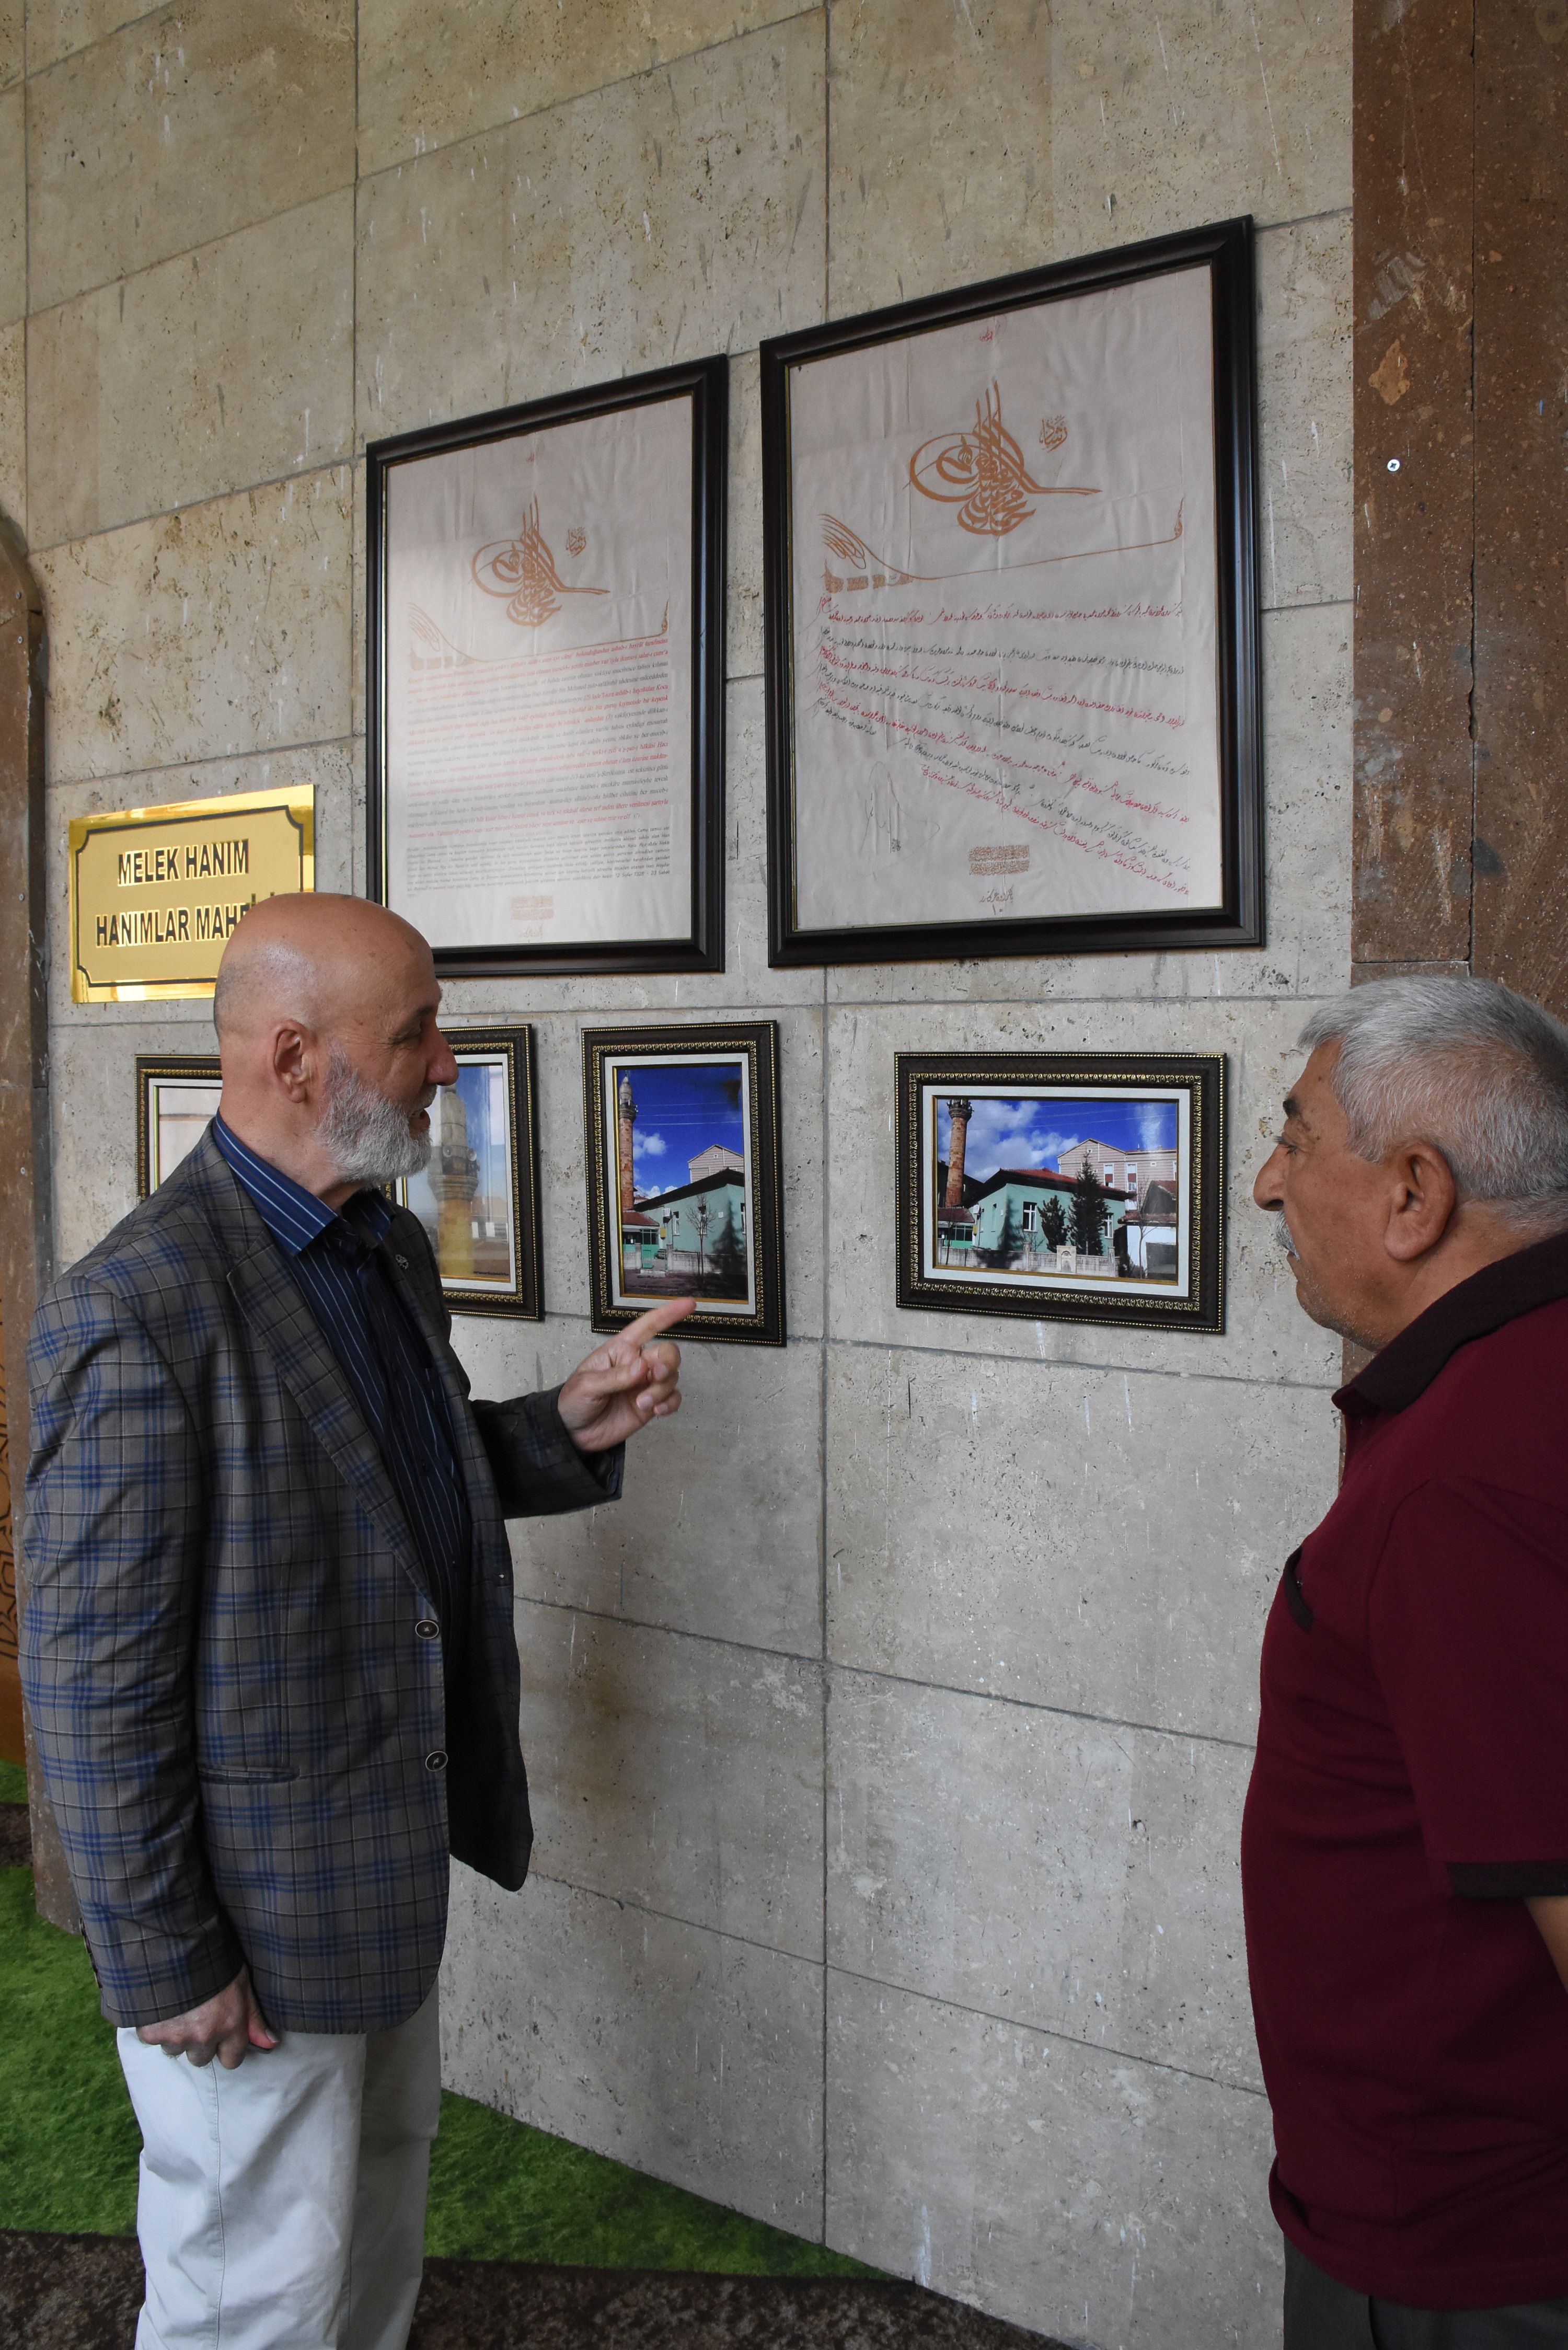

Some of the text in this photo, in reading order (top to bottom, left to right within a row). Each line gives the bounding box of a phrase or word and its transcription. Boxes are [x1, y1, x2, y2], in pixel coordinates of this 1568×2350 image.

[118, 838, 249, 886] MELEK HANIM
[95, 907, 190, 948] HANIMLAR
